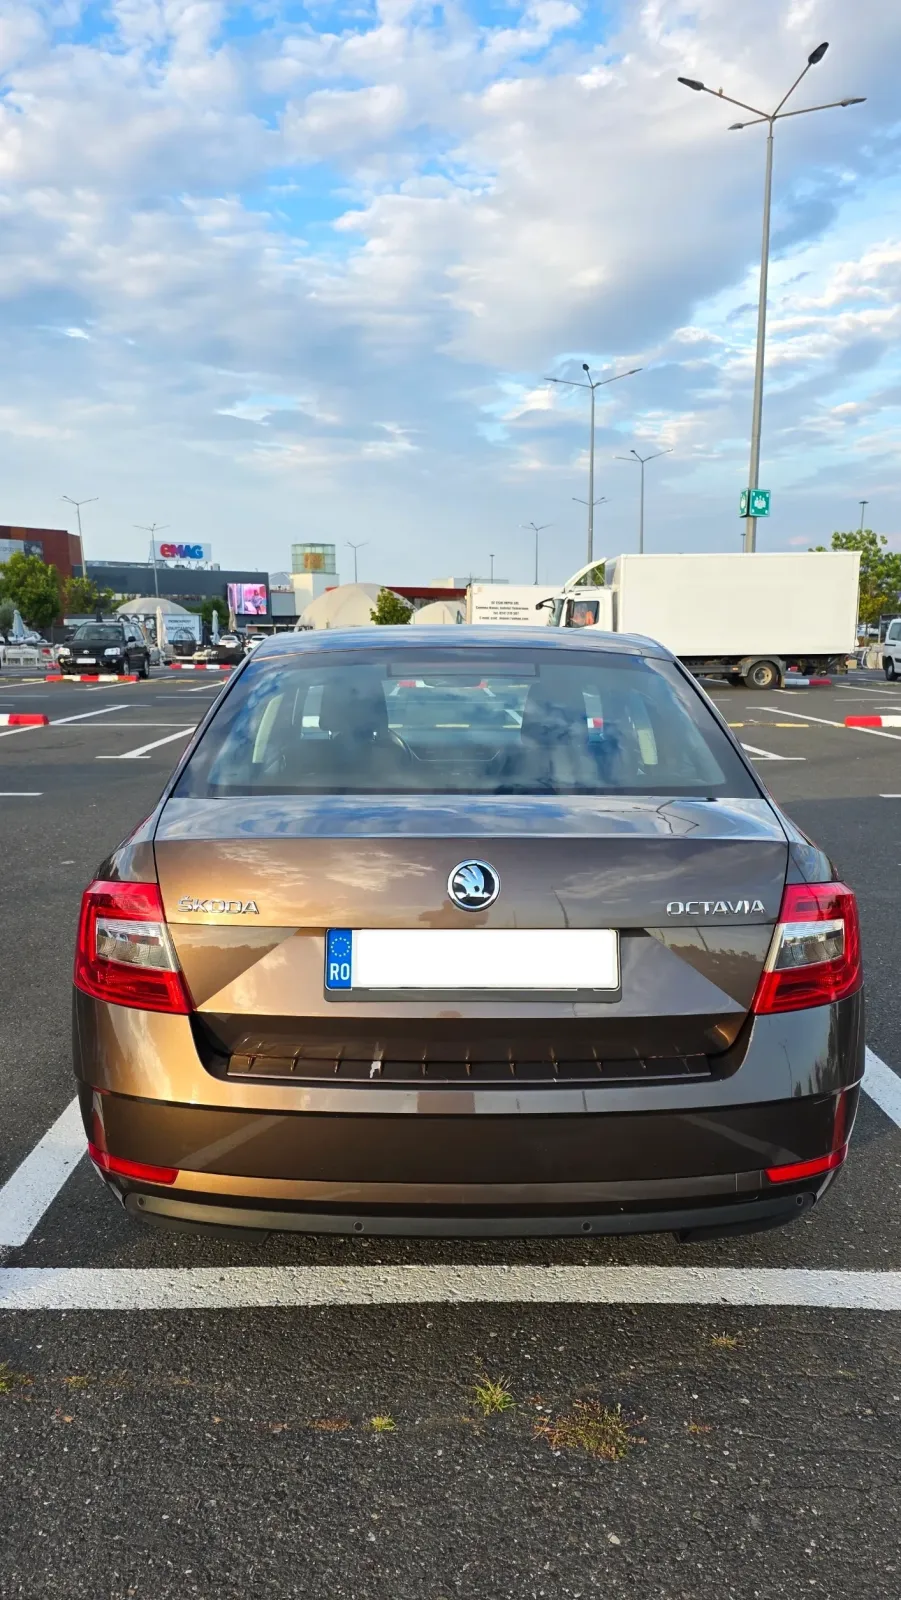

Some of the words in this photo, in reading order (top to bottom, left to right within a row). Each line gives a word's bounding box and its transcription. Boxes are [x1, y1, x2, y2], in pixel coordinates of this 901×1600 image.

[178, 895, 260, 914] ŠKODA
[666, 900, 765, 916] OCTAVIA
[329, 963, 350, 981] RO
